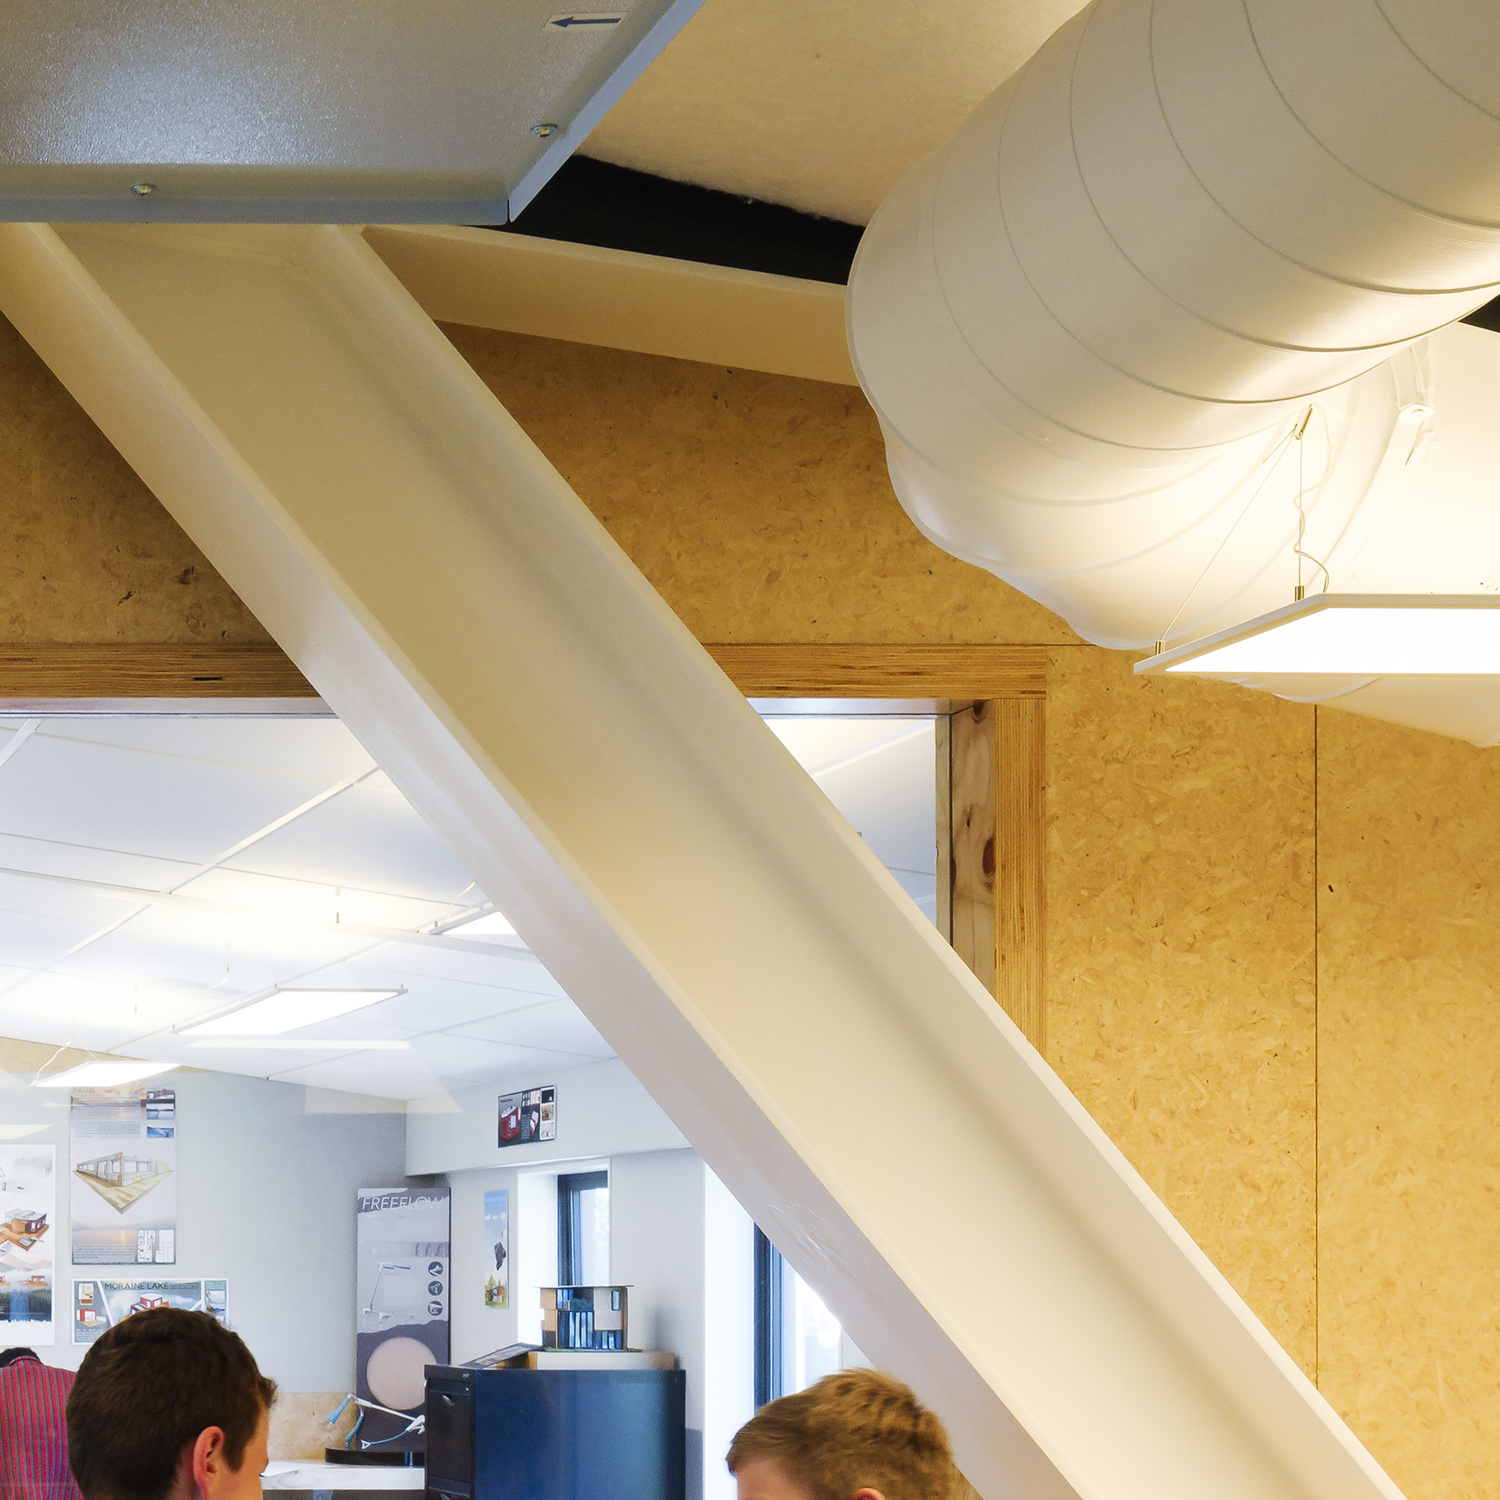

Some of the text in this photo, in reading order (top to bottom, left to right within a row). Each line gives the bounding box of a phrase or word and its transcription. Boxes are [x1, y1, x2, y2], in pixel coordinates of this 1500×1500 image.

[362, 1196, 445, 1211] FREEFLOW
[104, 1282, 145, 1290] MORAINE
[147, 1282, 169, 1290] LAKE
